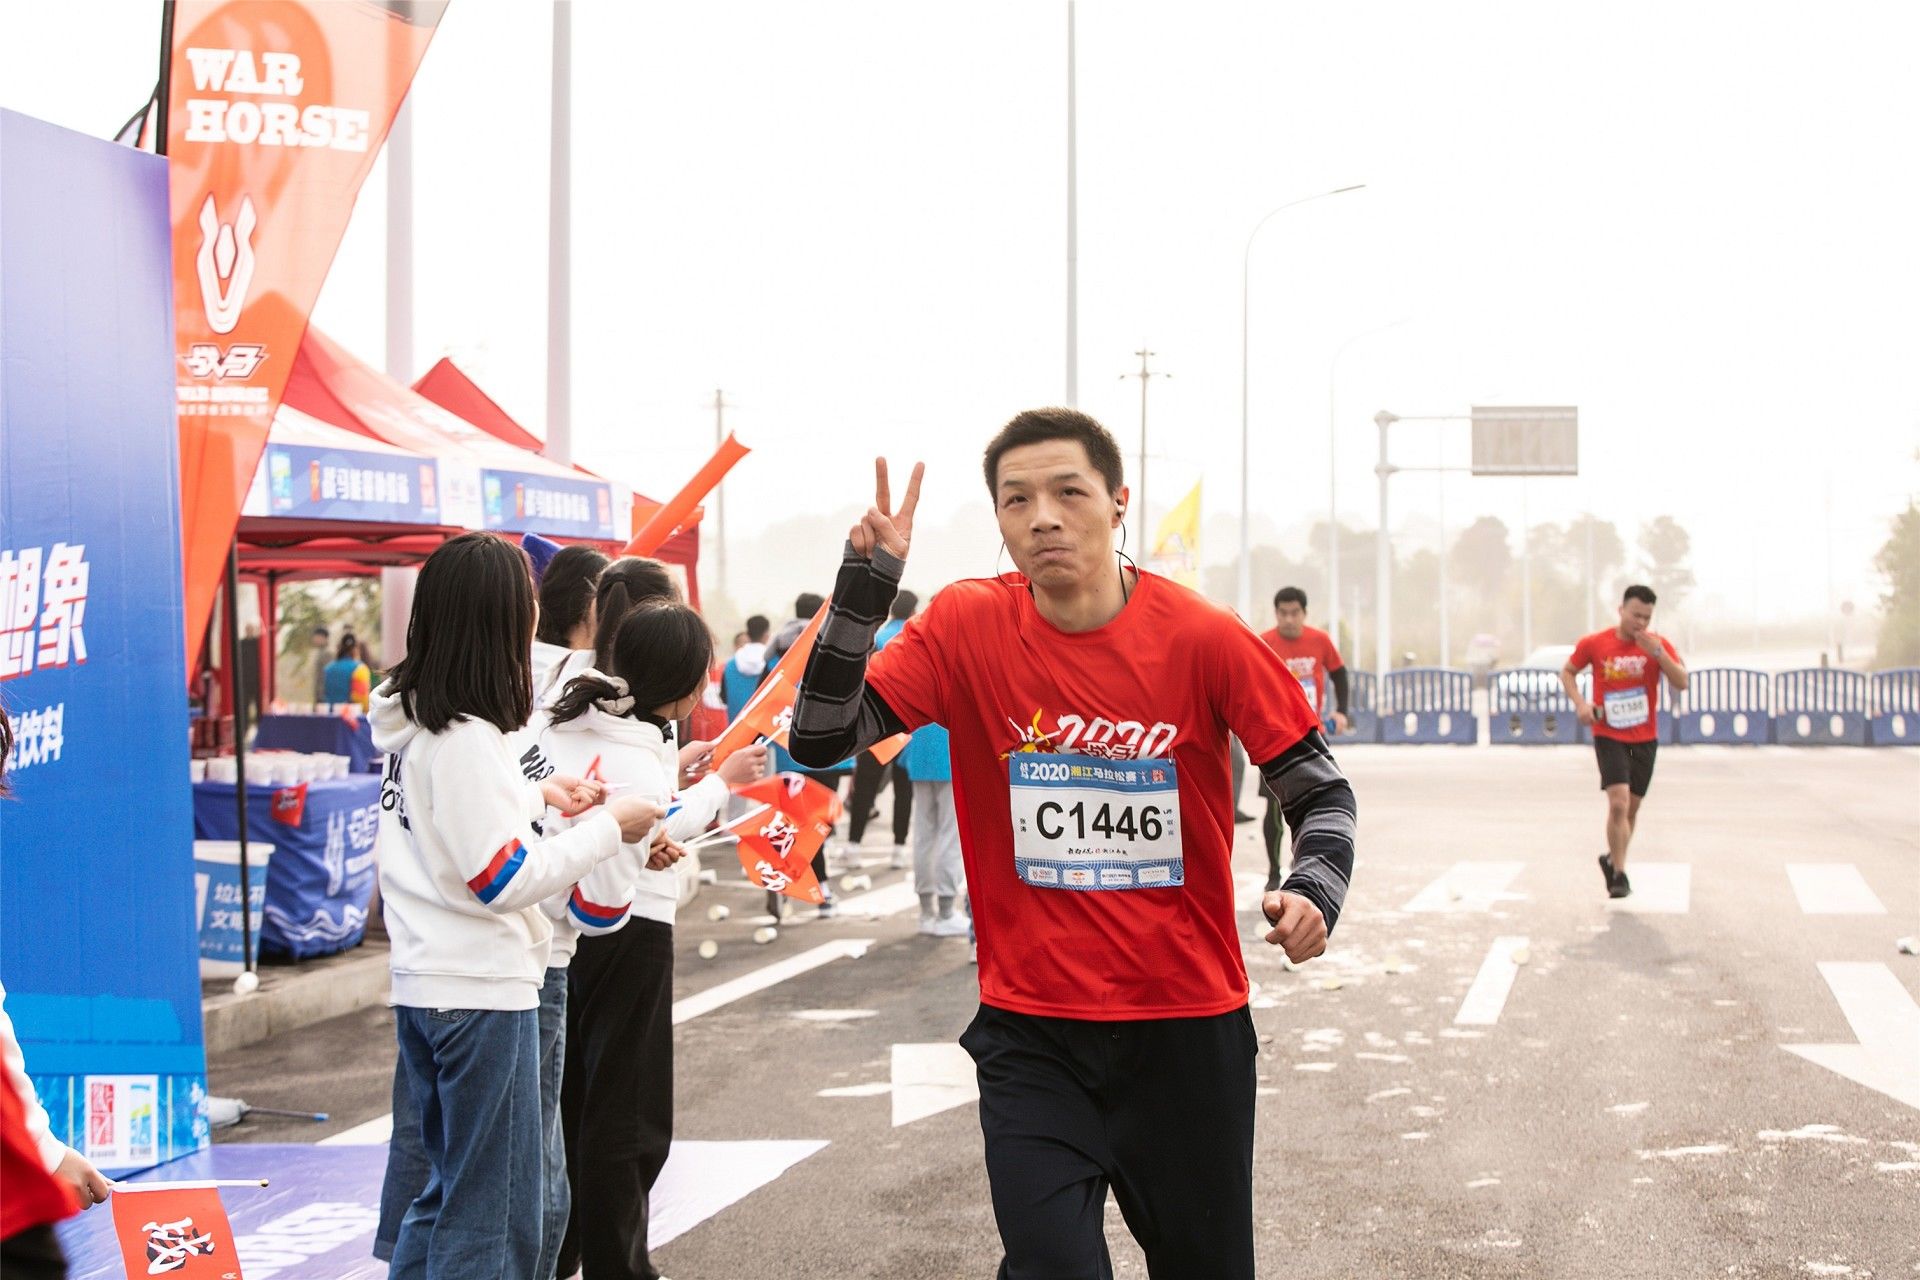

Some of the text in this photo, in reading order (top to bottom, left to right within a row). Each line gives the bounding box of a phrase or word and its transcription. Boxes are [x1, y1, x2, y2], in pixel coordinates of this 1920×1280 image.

[186, 48, 304, 97] WAR
[185, 98, 369, 152] HORSE
[1056, 714, 1177, 759] 2020
[1036, 801, 1162, 841] C1446
